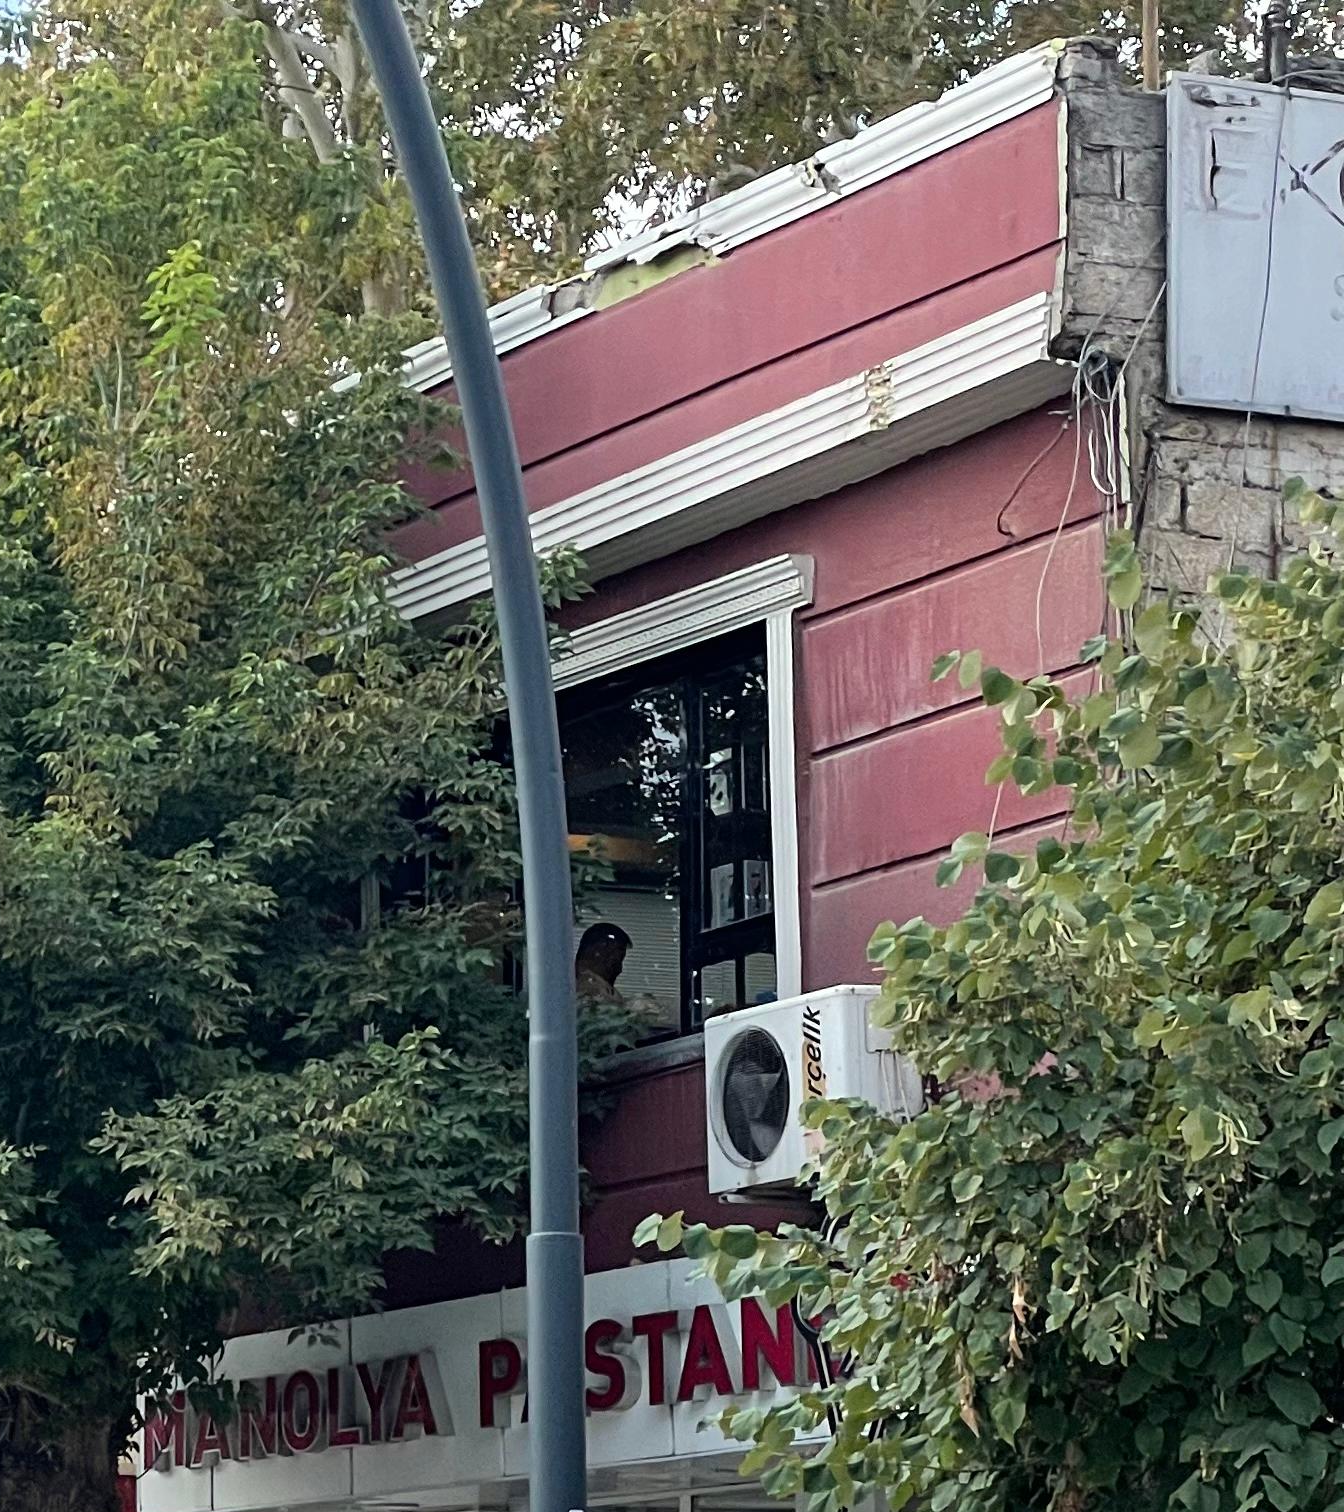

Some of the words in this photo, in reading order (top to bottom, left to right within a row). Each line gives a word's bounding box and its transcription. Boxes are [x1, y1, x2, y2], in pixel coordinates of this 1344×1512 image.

[802, 1005, 826, 1100] rçelik
[143, 1348, 449, 1472] MANOLYA
[478, 1297, 847, 1430] PSTAN
